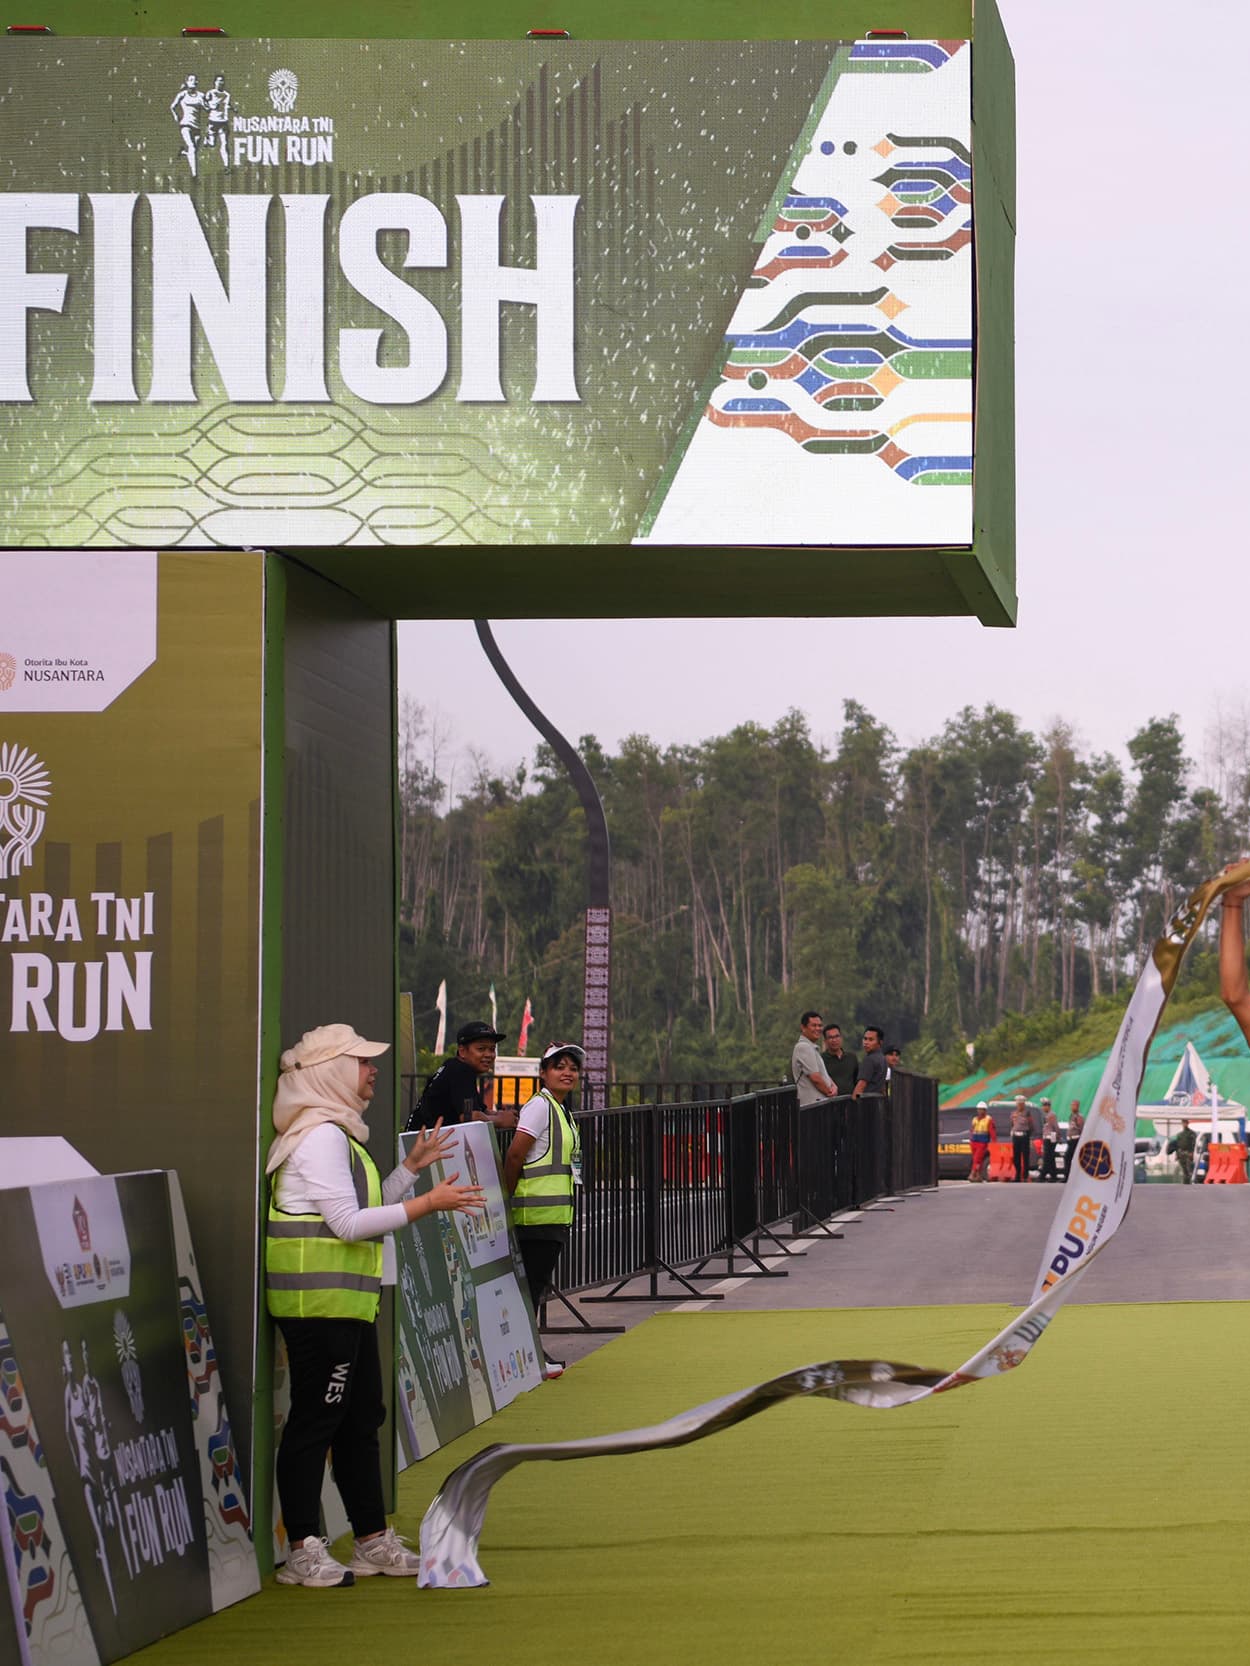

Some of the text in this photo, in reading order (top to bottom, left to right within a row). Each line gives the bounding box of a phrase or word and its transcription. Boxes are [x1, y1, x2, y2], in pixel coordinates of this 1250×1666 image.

[233, 116, 333, 133] NUSANTARA TNI
[233, 135, 333, 166] FUN RUN
[0, 192, 581, 404] FINISH
[24, 658, 88, 666] Otorita Ibu Kota
[24, 669, 105, 681] NUSANTARA
[91, 892, 154, 941] TNI
[9, 951, 153, 1042] RUN
[1050, 1195, 1101, 1276] PUPR
[325, 1362, 350, 1403] WES
[124, 1476, 194, 1574] FUN RUN
